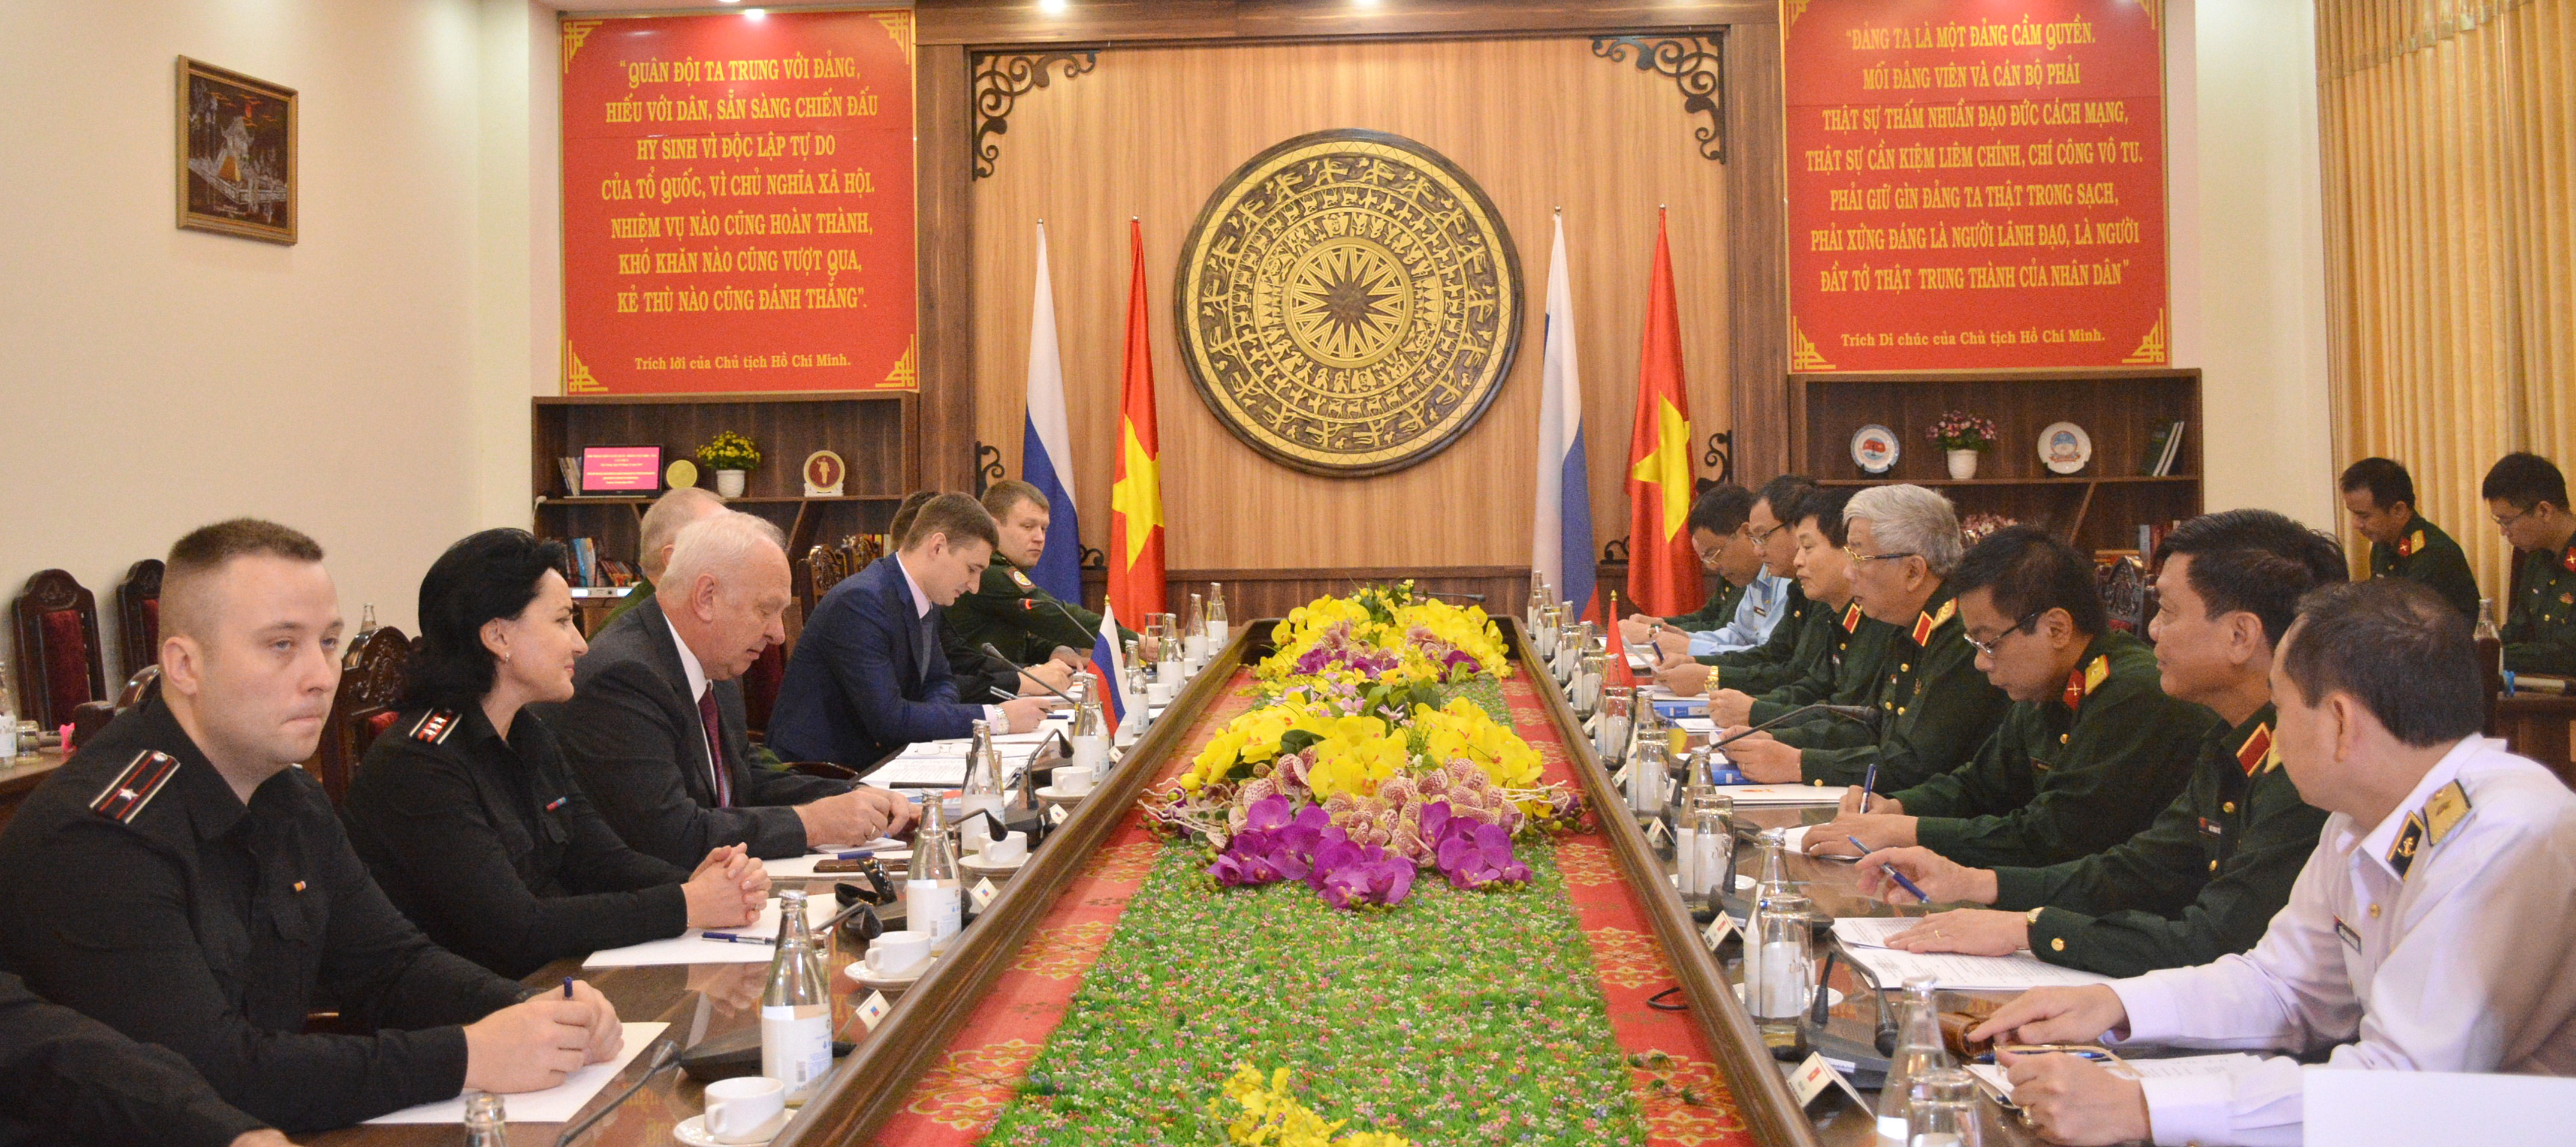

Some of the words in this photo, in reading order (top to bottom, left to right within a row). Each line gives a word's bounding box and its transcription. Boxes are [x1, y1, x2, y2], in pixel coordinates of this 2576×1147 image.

[1894, 28, 1913, 49] TA
[1916, 21, 1933, 48] LÀ
[1936, 20, 1967, 51] MỘT
[1970, 18, 2008, 47] ĐẢNG
[2011, 14, 2043, 46] CẦM
[675, 56, 701, 86] ĐỘI
[705, 61, 725, 82] TA
[728, 58, 780, 80] TRUNG
[783, 50, 810, 79] VỚI
[1893, 61, 1931, 89] ĐẢNG
[1933, 61, 1968, 88] VIÊN
[1971, 60, 1990, 87] VÀ
[1993, 59, 2020, 86] CÁN
[2025, 58, 2043, 89] BỘ
[2047, 55, 2081, 85] PHẢI
[607, 94, 643, 123] HIẾU
[647, 94, 674, 121] VỚI
[678, 95, 712, 121] DÂN,
[752, 92, 791, 119] SÀNG
[796, 88, 843, 118] CHIẾN
[847, 86, 879, 116] ĐẤU
[1821, 104, 1860, 134] THẬT
[1863, 106, 1881, 133] SỰ
[1886, 100, 1925, 130] THẤM
[1928, 98, 1975, 128] NHUẦN
[1979, 106, 2007, 130] ĐẠO
[2011, 100, 2040, 125] ĐỨC
[2043, 98, 2082, 125] CÁCH
[2085, 101, 2128, 128] MẠNG,
[637, 139, 658, 160] HY
[663, 138, 698, 159] SINH
[702, 131, 717, 158] VÌ
[722, 133, 753, 162] ĐỘC
[758, 131, 786, 160] LẬP
[791, 133, 810, 161] TỰ
[815, 134, 836, 155] DO
[1806, 145, 1842, 175] THẬT
[1846, 146, 1863, 175] SỰ
[1868, 140, 1896, 170] CẦN
[1900, 143, 1935, 173] KIỆM
[1939, 142, 1974, 168] LIÊM
[1978, 140, 2025, 167] CHÍNH,
[2028, 139, 2053, 165] CHÍ
[2058, 138, 2094, 164] CÔNG
[2098, 137, 2116, 163] VÔ
[602, 172, 633, 200] CỦA
[637, 167, 656, 198] TỔ
[661, 167, 706, 204] QUỐC,
[710, 170, 727, 196] VÌ
[731, 167, 762, 195] CHỦ
[767, 170, 815, 195] NGHĨA
[818, 168, 841, 194] XÃ
[844, 167, 876, 198] HỘI.
[1831, 182, 1863, 211] PHẢI
[1866, 183, 1892, 210] GIỮ
[1896, 182, 1919, 209] GÌN
[1923, 179, 1962, 208] ĐẢNG
[1965, 186, 1984, 207] TA
[1986, 180, 2023, 211] THẬT
[2026, 183, 2074, 206] TRONG
[2078, 182, 2119, 209] SẠCH,
[611, 212, 661, 242] NHIỆM
[665, 216, 685, 241] VỤ
[690, 209, 721, 236] NÀO
[725, 210, 766, 235] CŨNG
[771, 207, 812, 234] HOÀN
[816, 207, 874, 234] THÀNH,
[1811, 222, 1844, 251] PHẢI
[1889, 222, 1927, 249] ĐÁNG
[1930, 222, 1949, 248] LÀ
[1952, 221, 1995, 248] NGƯỜI
[1998, 221, 2035, 247] LÃNH
[2038, 223, 2071, 250] ĐẠO,
[2076, 217, 2094, 245] LÀ
[2097, 217, 2140, 246] NGƯỜI
[619, 248, 651, 275] KHÓ
[656, 247, 698, 273] KHĂN
[702, 246, 733, 272] NÀO
[737, 246, 779, 272] CŨNG
[783, 246, 823, 275] VƯỢT
[828, 249, 862, 278] QUA,
[1821, 261, 1848, 292] ĐẦY
[1852, 263, 1871, 291] TỚ
[1875, 264, 1913, 294] THẬT
[1919, 267, 1965, 289] TRUNG
[1969, 261, 2016, 289] THÀNH
[2020, 258, 2050, 288] CỦA
[2051, 260, 2089, 287] NHÂN
[618, 285, 639, 313] KẺ
[644, 286, 674, 312] THÙ
[679, 285, 709, 312] NÀO
[713, 285, 755, 311] CŨNG
[759, 282, 801, 310] ĐÁNH
[1842, 333, 1875, 347] Trích
[1880, 333, 1895, 345] Di
[1898, 333, 1929, 345] chúc
[1933, 331, 1956, 345] của
[1960, 330, 1987, 345] Chủ
[1991, 330, 2016, 347] tịch
[2021, 326, 2039, 344] Hồ
[2043, 330, 2066, 343] Chí
[2069, 328, 2105, 343] Minh.
[635, 357, 667, 369] Trích
[671, 357, 686, 369] lời
[690, 359, 711, 369] của
[715, 356, 740, 369] Chủ
[744, 355, 768, 371] tịch
[772, 353, 788, 367] Hồ
[792, 354, 813, 367] Chí
[817, 353, 850, 366] Minh.
